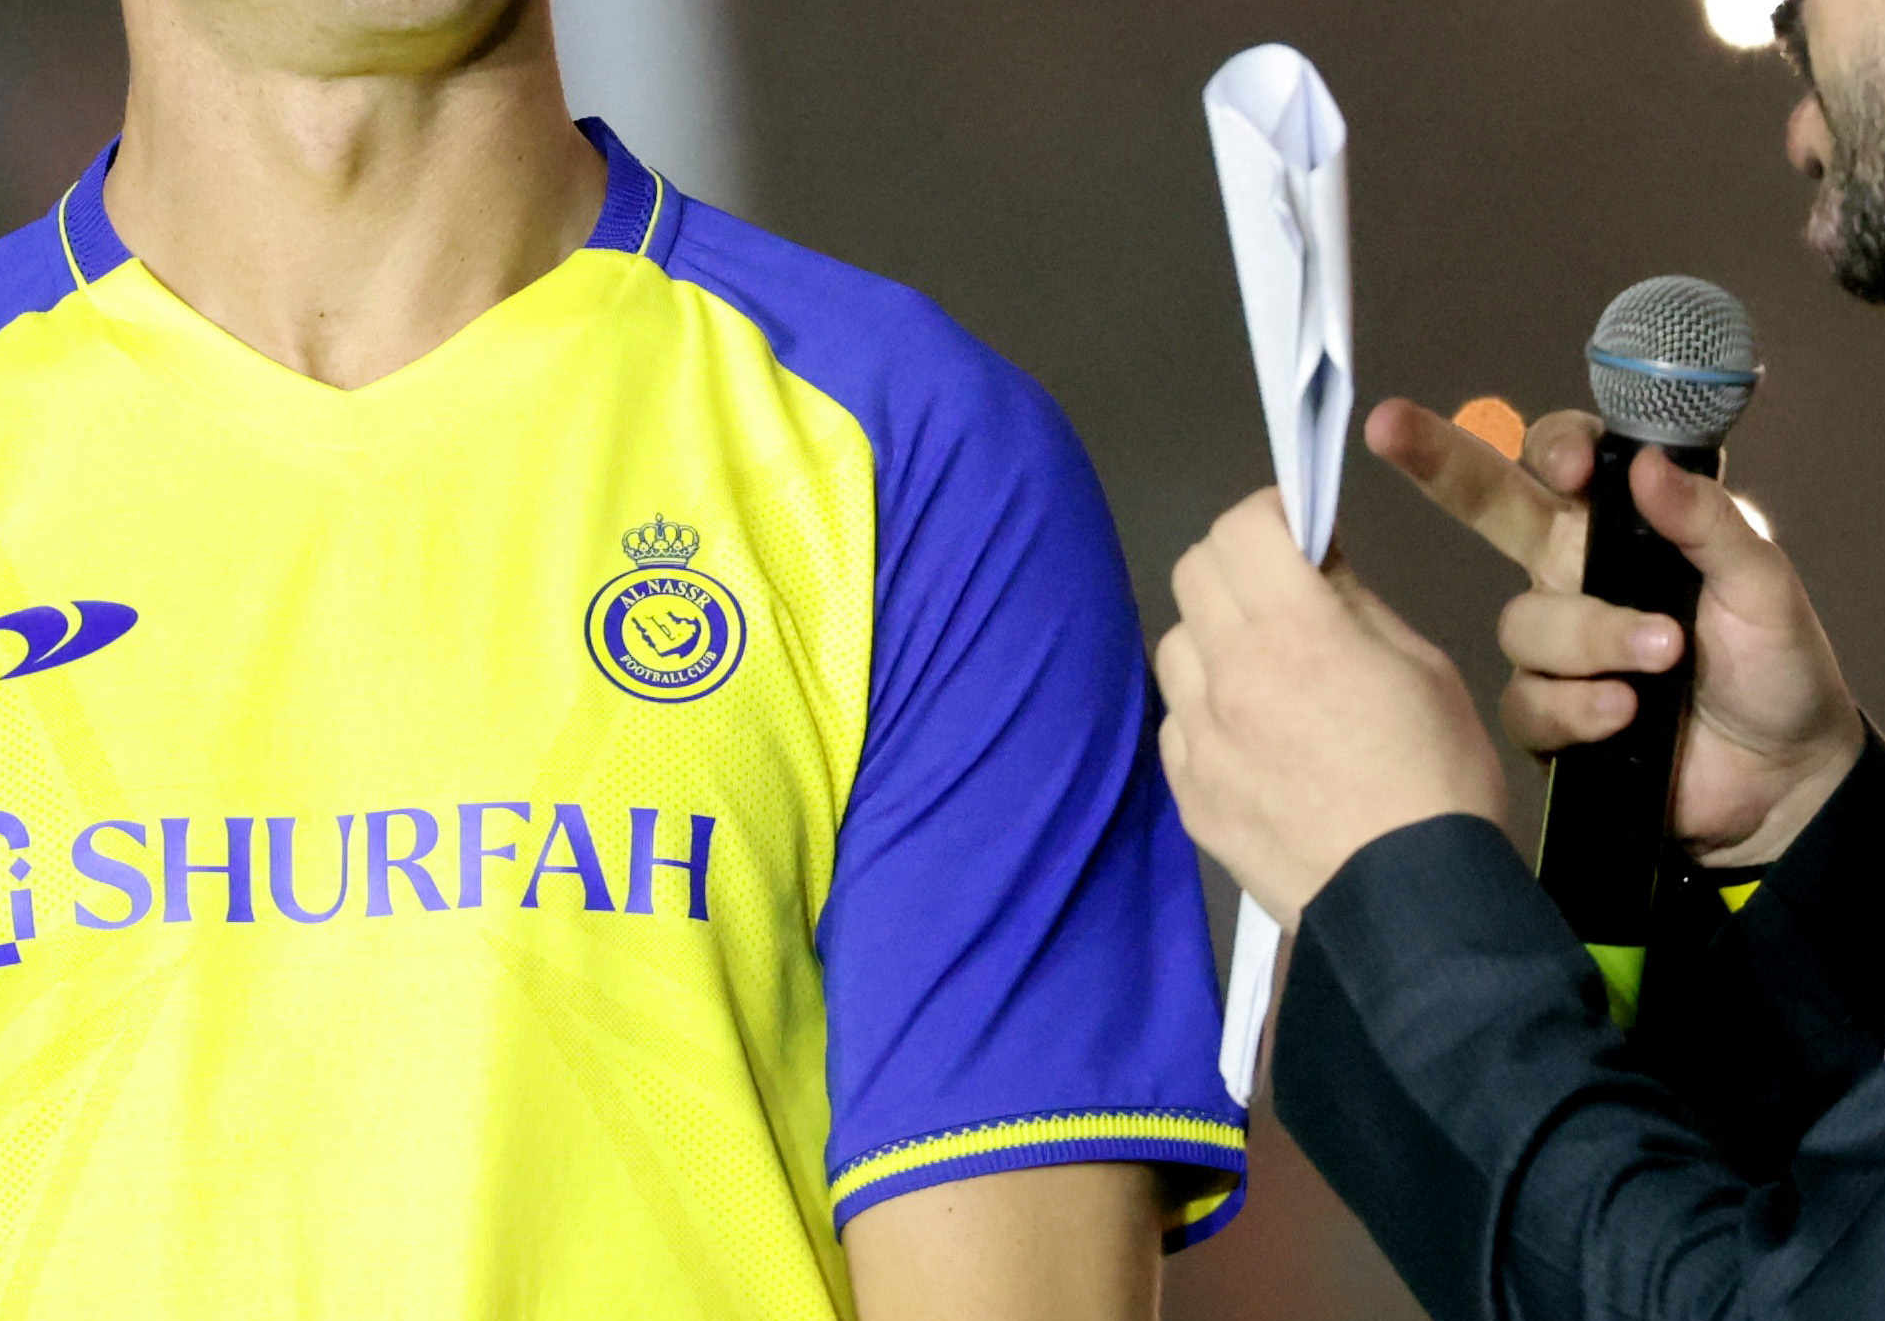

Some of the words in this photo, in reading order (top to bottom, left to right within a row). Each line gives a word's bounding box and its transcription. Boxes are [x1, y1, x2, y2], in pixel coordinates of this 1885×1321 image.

[620, 587, 646, 610] AL
[646, 579, 712, 611] NASSR
[619, 654, 689, 685] FOOTBALL
[687, 651, 718, 678] CLUB
[72, 801, 716, 931] SHURFAH
